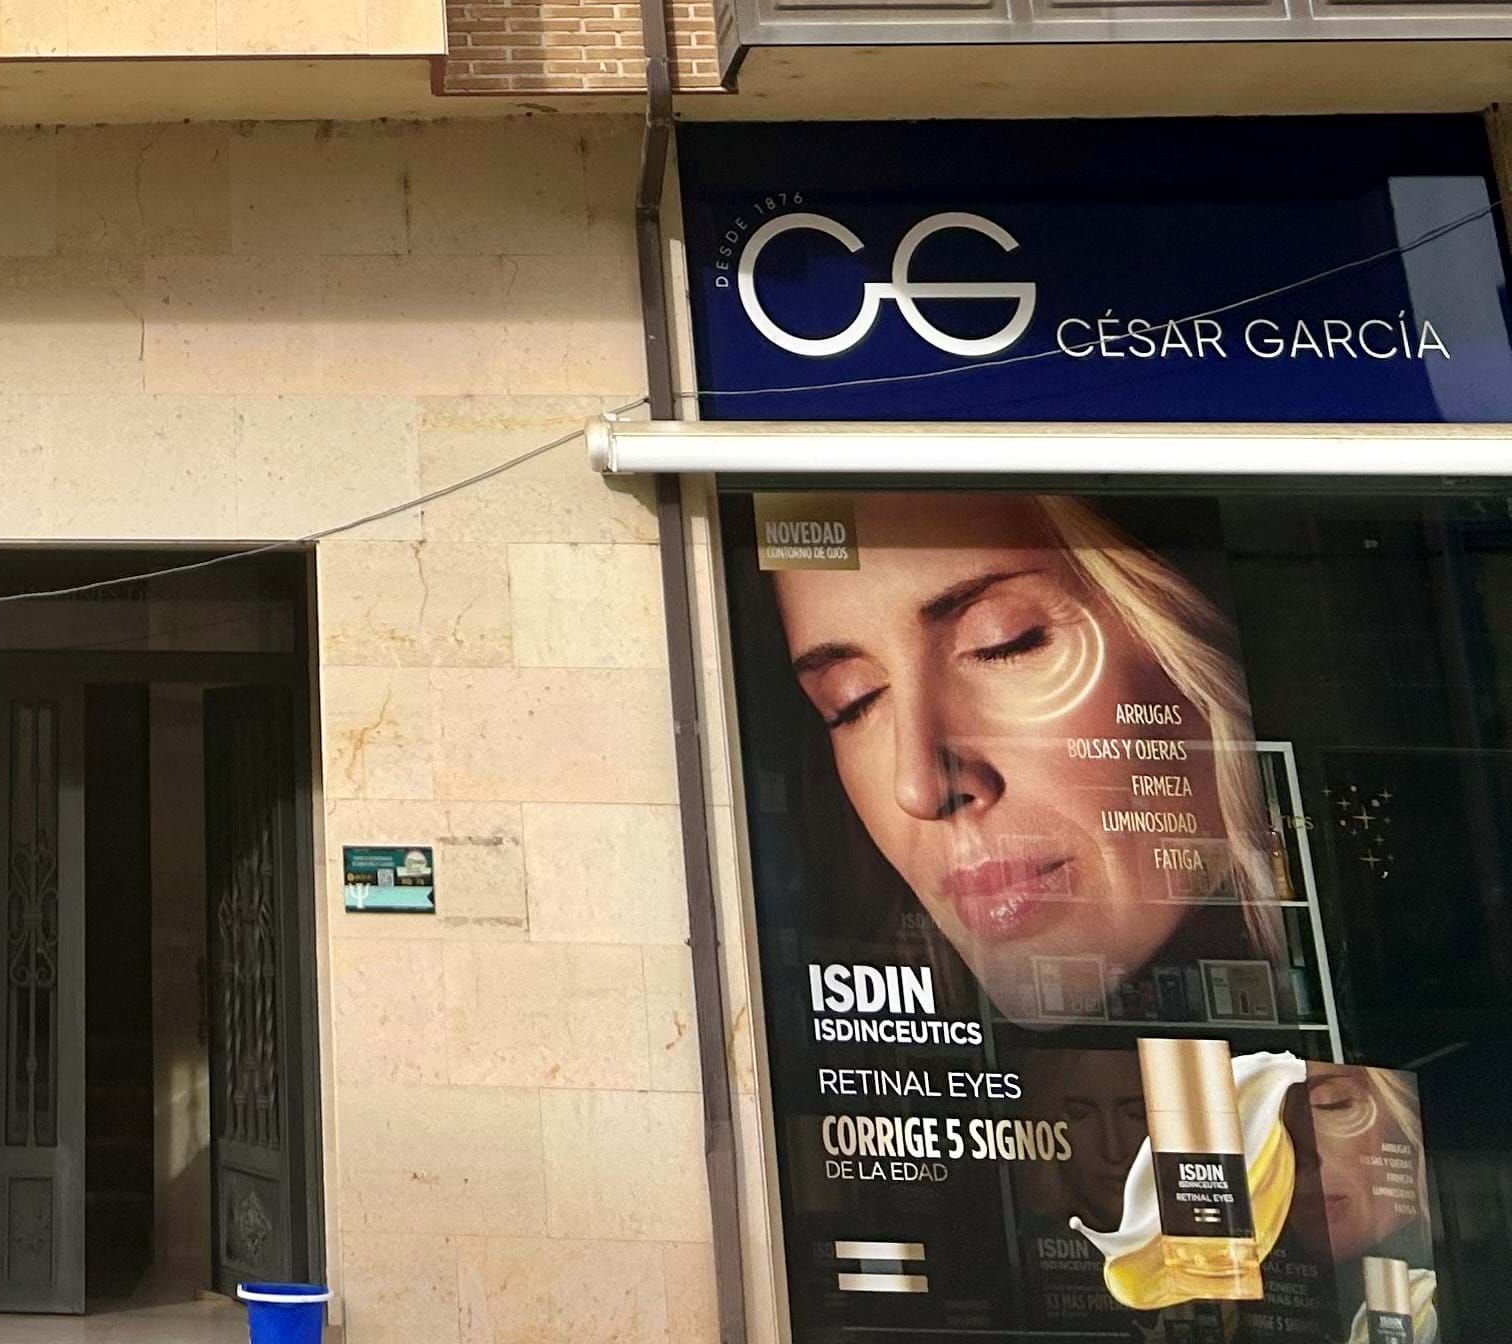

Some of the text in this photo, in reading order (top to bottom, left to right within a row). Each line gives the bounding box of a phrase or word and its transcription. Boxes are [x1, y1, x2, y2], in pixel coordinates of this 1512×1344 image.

[715, 192, 803, 288] DESDE 1876
[1056, 308, 1451, 358] CÉSAR GARCÍA
[765, 521, 846, 544] NOVEDAD
[813, 547, 826, 559] DE
[1116, 703, 1182, 725] ARRUGAS
[1067, 738, 1188, 761] BOLSAS Y OJERAS
[1131, 775, 1192, 797] FIRMEZA
[1101, 810, 1197, 834] LUMINOSIDAD
[1153, 848, 1204, 870] FATIGA
[808, 963, 936, 1014] ISDIN
[813, 1017, 983, 1045] ISDINCEUTICS
[819, 1069, 1022, 1099] RETINAL EYES
[822, 1115, 1073, 1161] CORRIGE 5 SIGNOS
[825, 1160, 948, 1182] DE LA EDAD
[1178, 1163, 1225, 1181] ISDIN
[1176, 1192, 1234, 1203] RETINAL EYES
